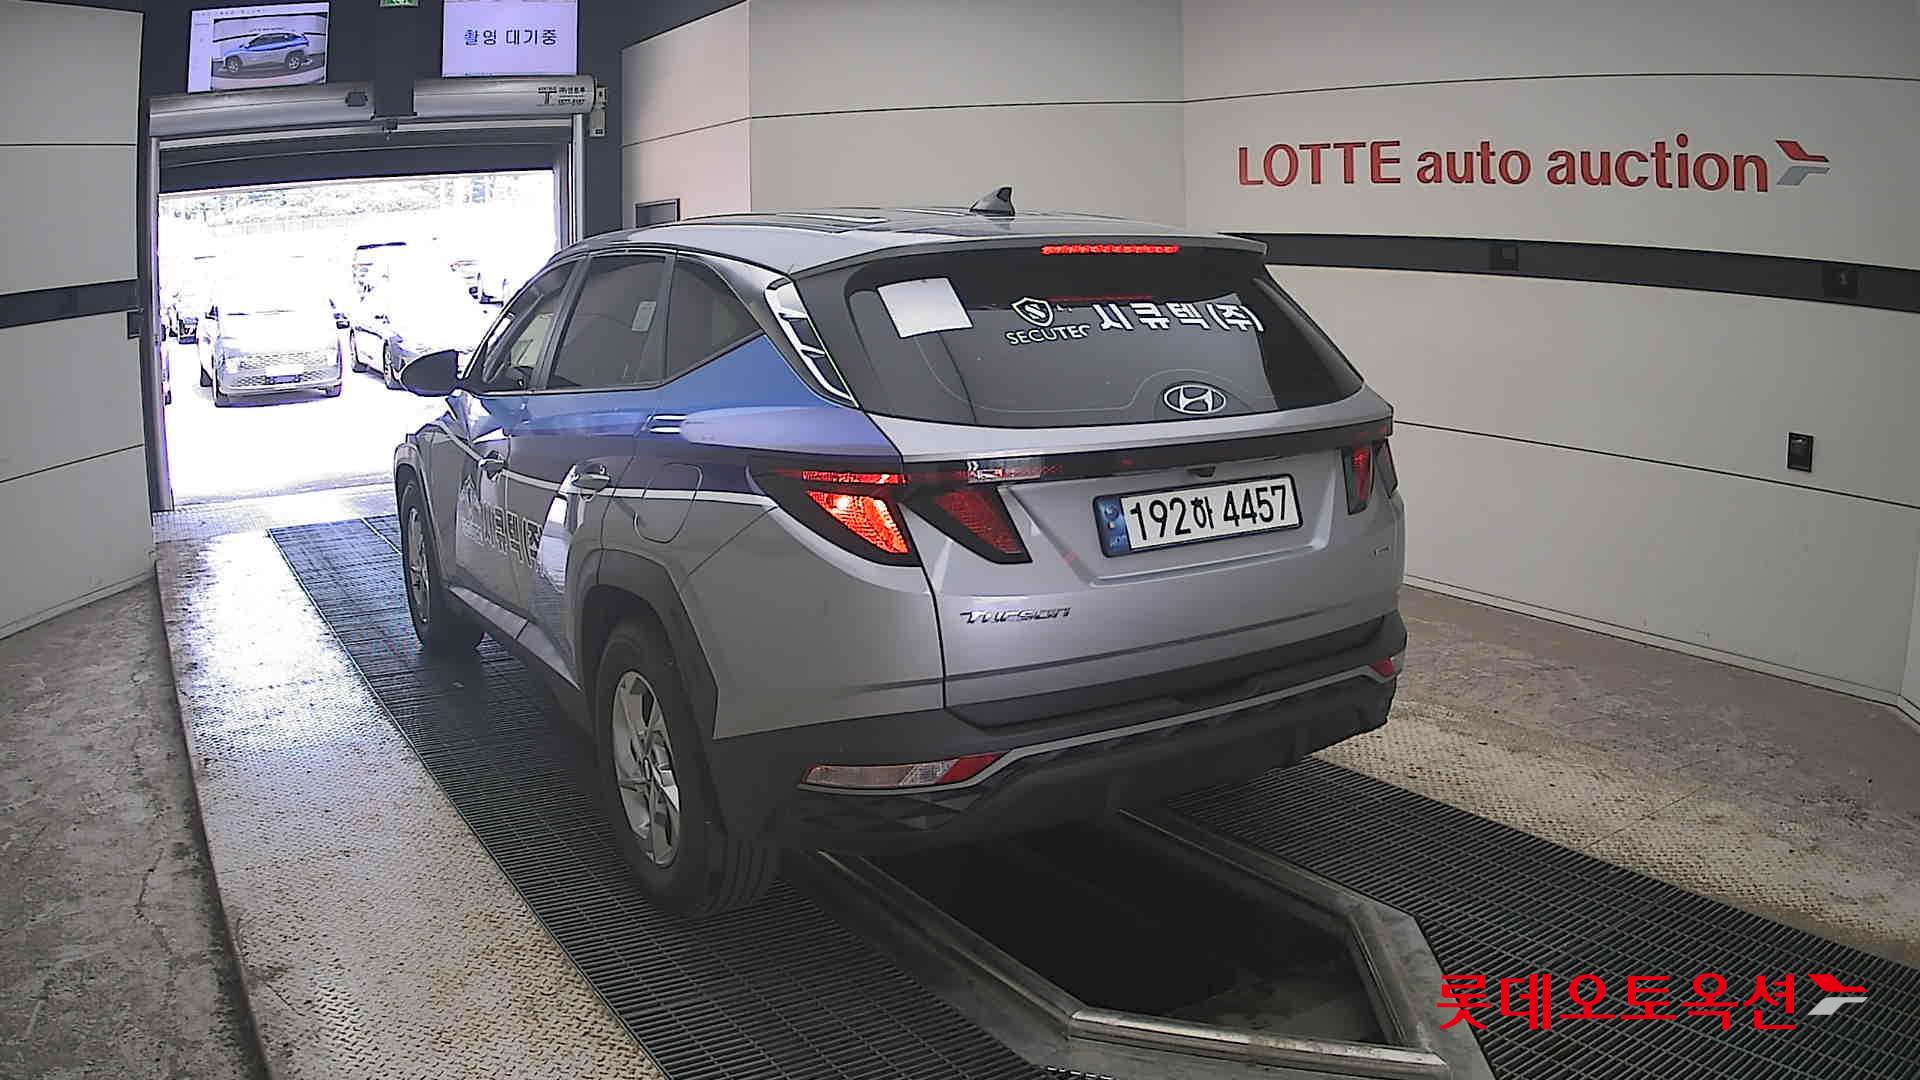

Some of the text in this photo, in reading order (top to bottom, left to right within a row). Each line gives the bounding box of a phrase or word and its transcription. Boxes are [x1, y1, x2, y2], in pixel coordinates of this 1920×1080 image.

[505, 29, 557, 46] 대기중
[1238, 133, 1769, 193] LOTTE auto auction
[1091, 302, 1265, 333] 시큐텍(주)
[1130, 484, 1287, 541] 192하 4457
